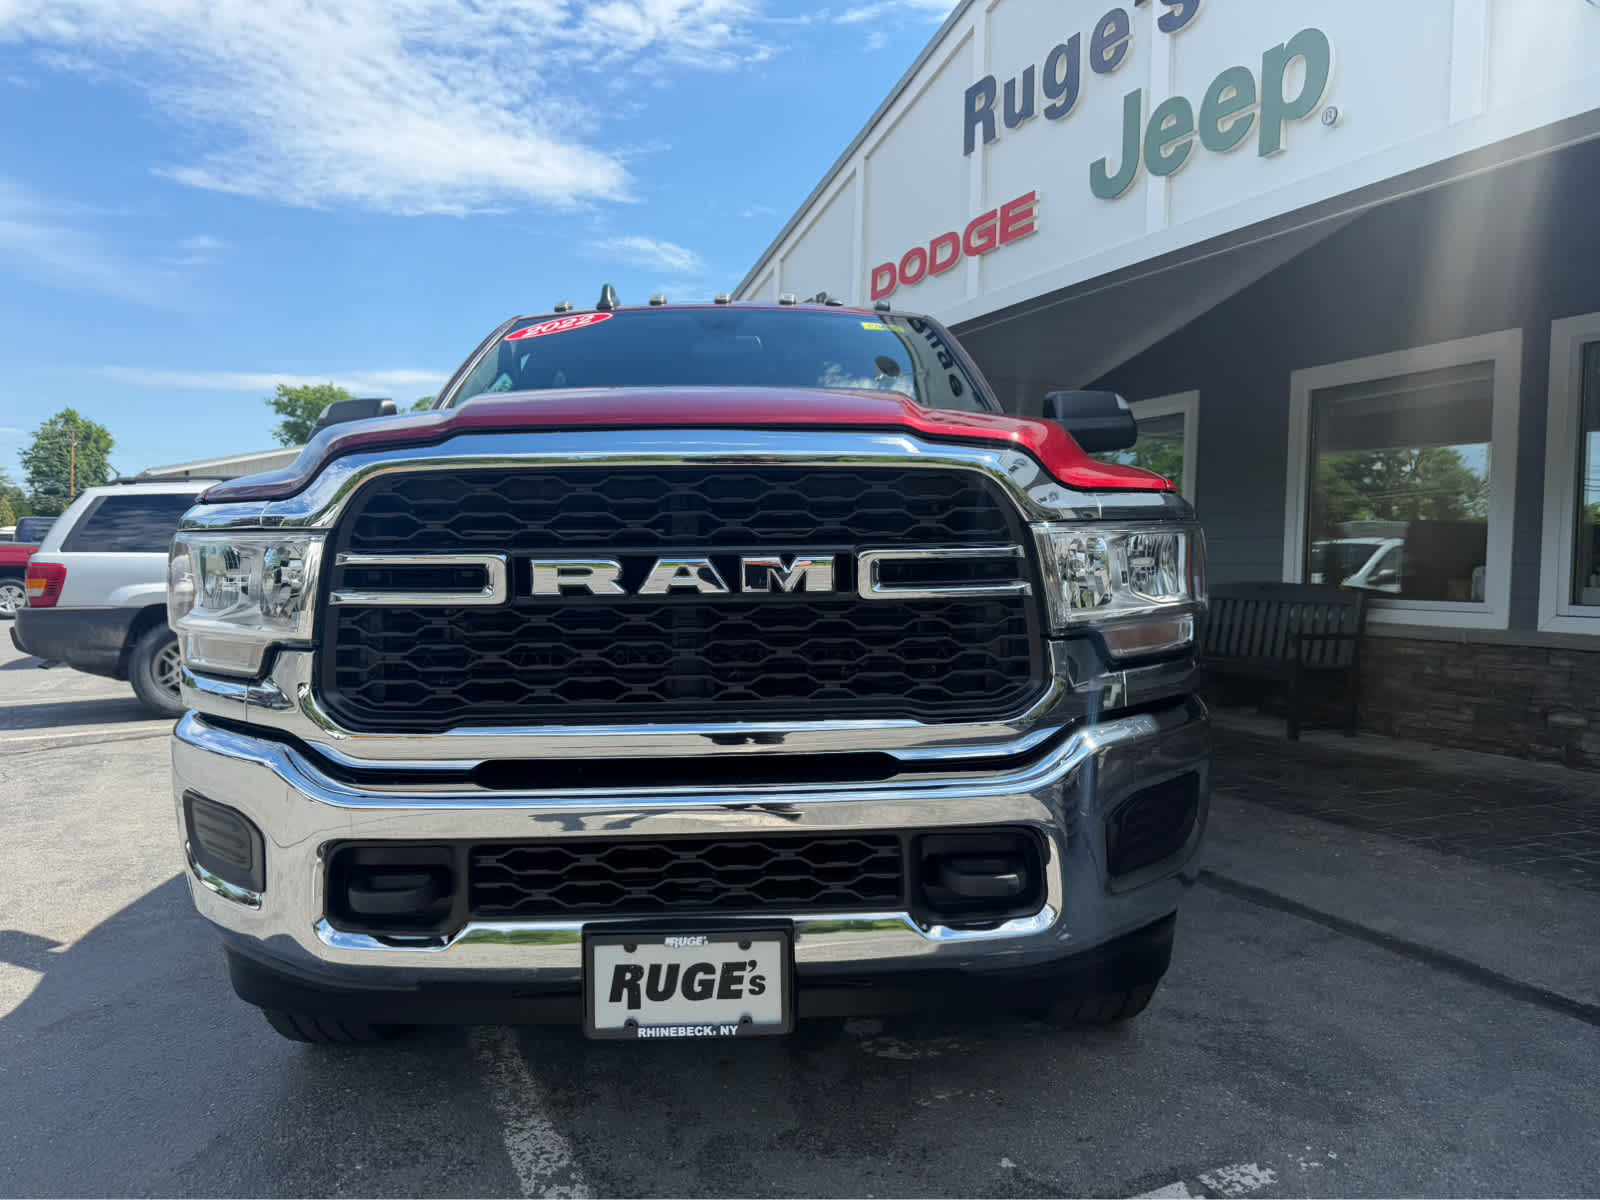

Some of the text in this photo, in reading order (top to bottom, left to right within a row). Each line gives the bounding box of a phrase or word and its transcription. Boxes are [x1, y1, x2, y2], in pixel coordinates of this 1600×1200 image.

[963, 0, 1201, 157] Ruges
[1089, 27, 1331, 200] Jeep
[871, 190, 1037, 302] DODGE
[530, 556, 836, 595] RAM
[608, 959, 767, 1010] RUGE's
[637, 1024, 739, 1038] RHINEBECK, NY
